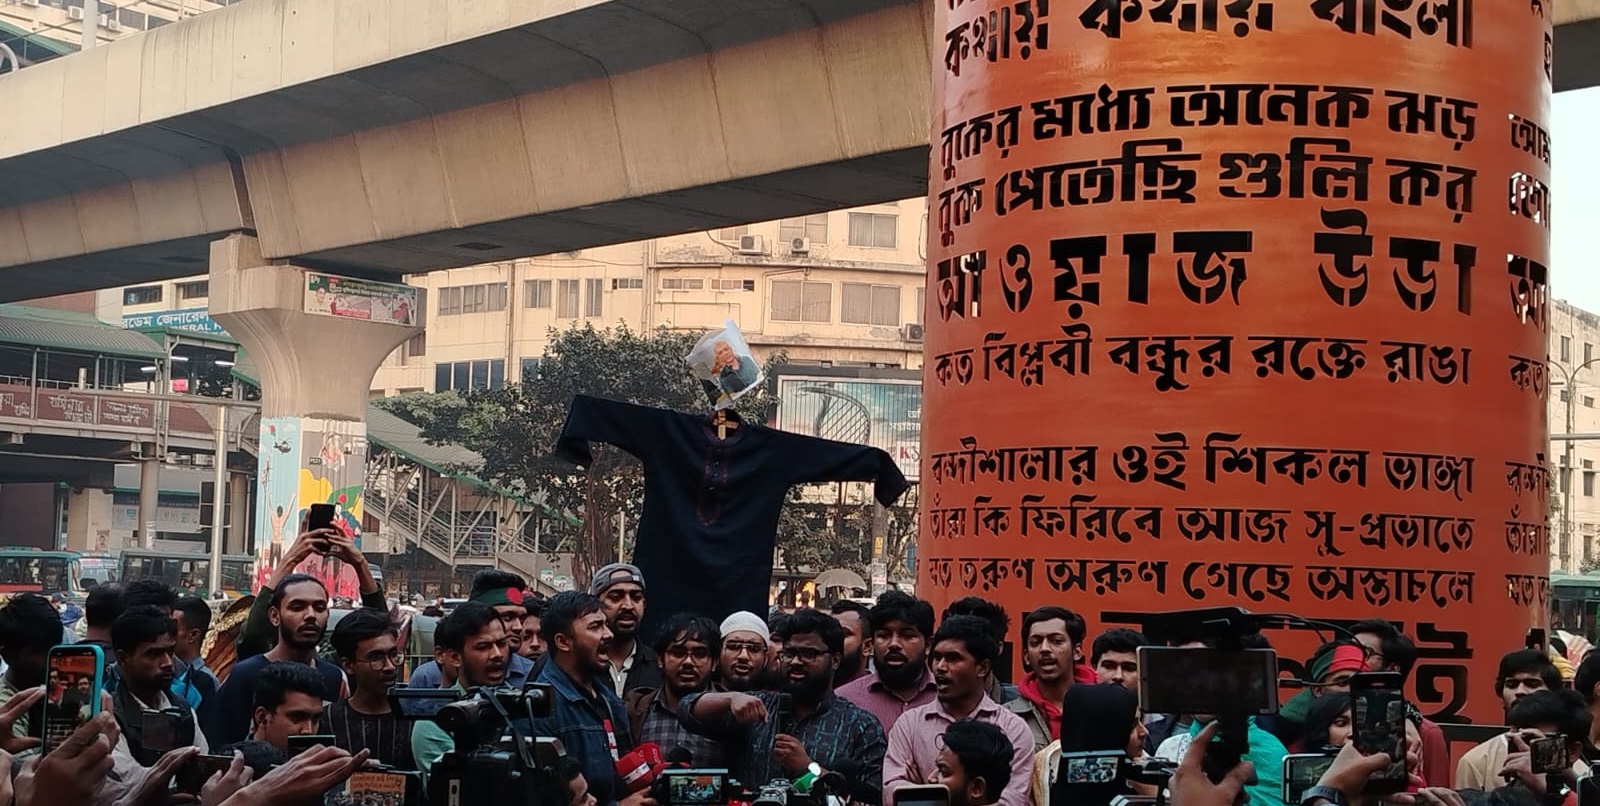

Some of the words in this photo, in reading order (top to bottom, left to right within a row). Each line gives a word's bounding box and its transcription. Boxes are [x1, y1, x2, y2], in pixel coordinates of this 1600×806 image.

[944, 0, 1049, 77] কথায়
[940, 104, 1023, 181] বুকের
[1030, 79, 1152, 141] মধ্যে
[1166, 83, 1374, 128] অনেক
[1384, 90, 1478, 151] ঝড়
[938, 177, 986, 248] বুক
[995, 137, 1202, 217] পেতেছি
[1219, 137, 1373, 201] গুলি
[1385, 158, 1477, 223] কর
[934, 349, 974, 387] কত
[982, 323, 1092, 386] বিপ্লবী
[1105, 335, 1233, 392] বন্ধুর
[1247, 336, 1367, 381] রক্তে
[1380, 341, 1471, 385] রাঙা
[931, 436, 1098, 486] বন্দীশালার
[1113, 432, 1190, 491] ওই
[1202, 432, 1370, 488] শিকল
[929, 493, 967, 539] তাঁরা
[973, 495, 1011, 536] কি
[1019, 494, 1163, 543] ফিরিবে
[1175, 507, 1291, 543] আজ
[1303, 510, 1475, 557] সু-প্রভাতে
[959, 558, 1035, 592] তরুণ
[1045, 559, 1169, 596] অরুণ
[1182, 562, 1293, 602] গেছে
[1305, 565, 1475, 608] অস্তাচলে
